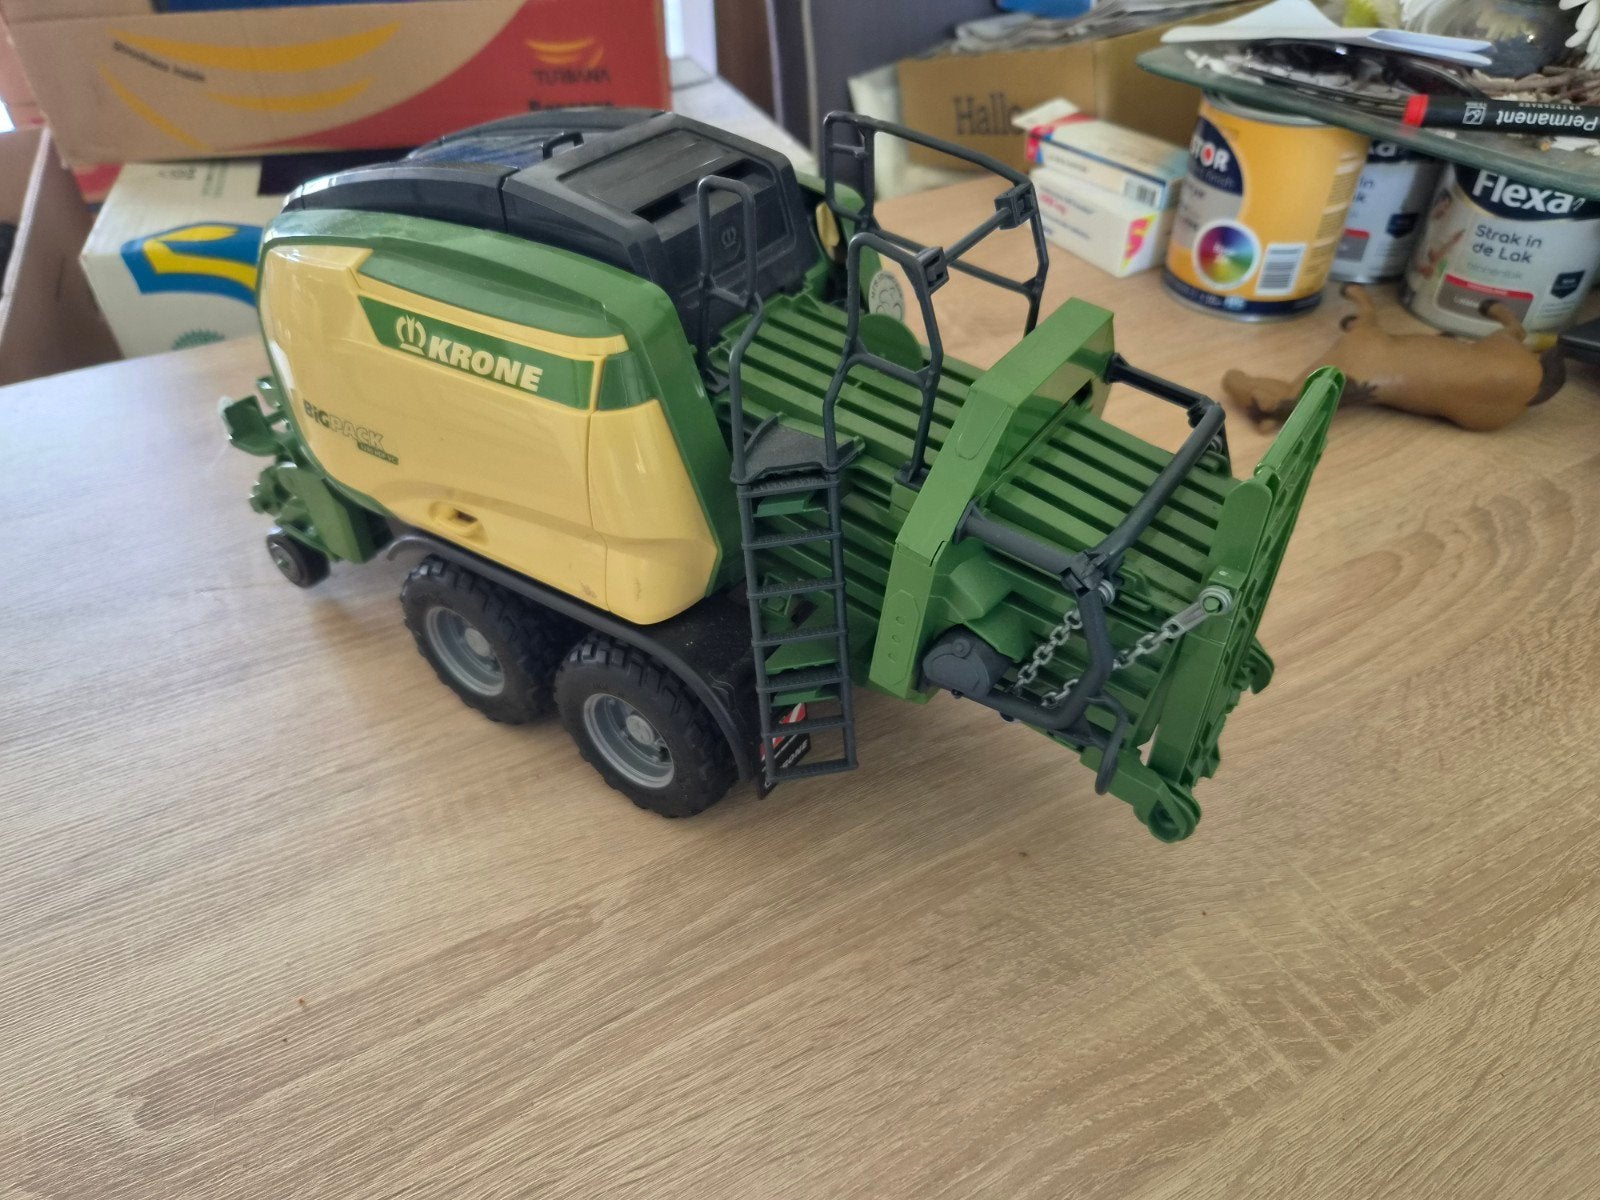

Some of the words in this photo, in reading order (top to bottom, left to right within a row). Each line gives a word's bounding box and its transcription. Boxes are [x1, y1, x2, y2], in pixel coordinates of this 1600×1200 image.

[1496, 111, 1598, 131] Permanent
[1472, 169, 1574, 214] Flexa
[1475, 224, 1521, 246] Strak
[1526, 234, 1542, 249] in
[1472, 242, 1493, 257] de
[1498, 246, 1532, 263] Lak
[428, 335, 543, 392] KRONE
